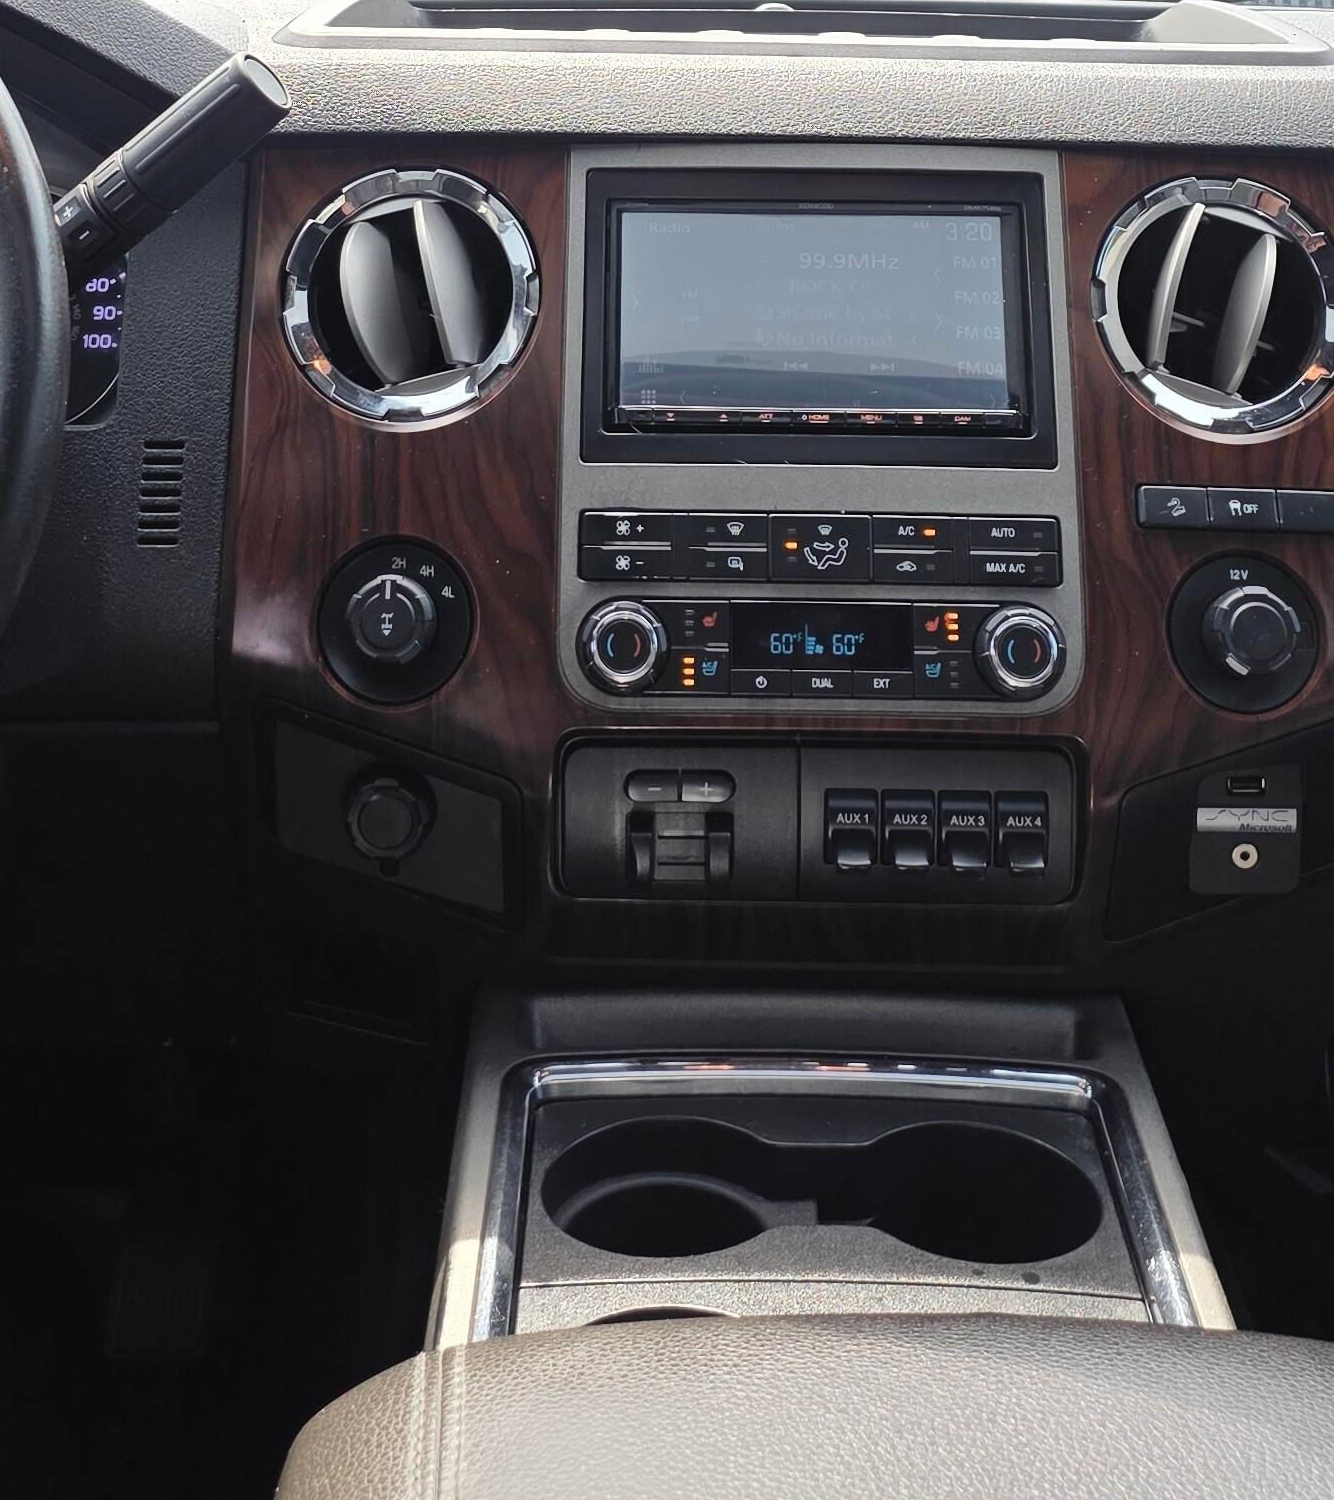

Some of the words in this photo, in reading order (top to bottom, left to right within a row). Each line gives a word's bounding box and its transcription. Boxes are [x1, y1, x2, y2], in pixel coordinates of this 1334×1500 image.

[649, 222, 691, 234] Radio
[799, 252, 900, 269] 99.9MHz
[953, 257, 977, 269] FM
[85, 277, 110, 293] 80
[954, 291, 979, 304] FM
[92, 305, 117, 321] 90
[955, 326, 980, 339] FM
[83, 333, 112, 349] 100
[957, 362, 983, 375] FM
[1243, 504, 1259, 514] OFF
[898, 525, 916, 537] A/C
[990, 527, 1016, 539] AUTO
[390, 557, 407, 570] 2H
[986, 561, 1008, 574] MAX
[1009, 562, 1027, 575] A/C
[419, 565, 435, 578] 4H
[1229, 569, 1249, 581] 12V
[441, 586, 455, 599] 4L
[811, 678, 834, 689] DUAL
[873, 678, 891, 689] EXT
[836, 813, 862, 825] AUX
[893, 814, 918, 825] AUX
[920, 814, 928, 825] 2
[950, 815, 976, 826] AUX
[977, 815, 986, 826] 3
[1006, 816, 1033, 827] AUX
[1034, 816, 1042, 827] 4
[1205, 809, 1290, 822] SYNC
[1238, 823, 1293, 833] Microsoft
